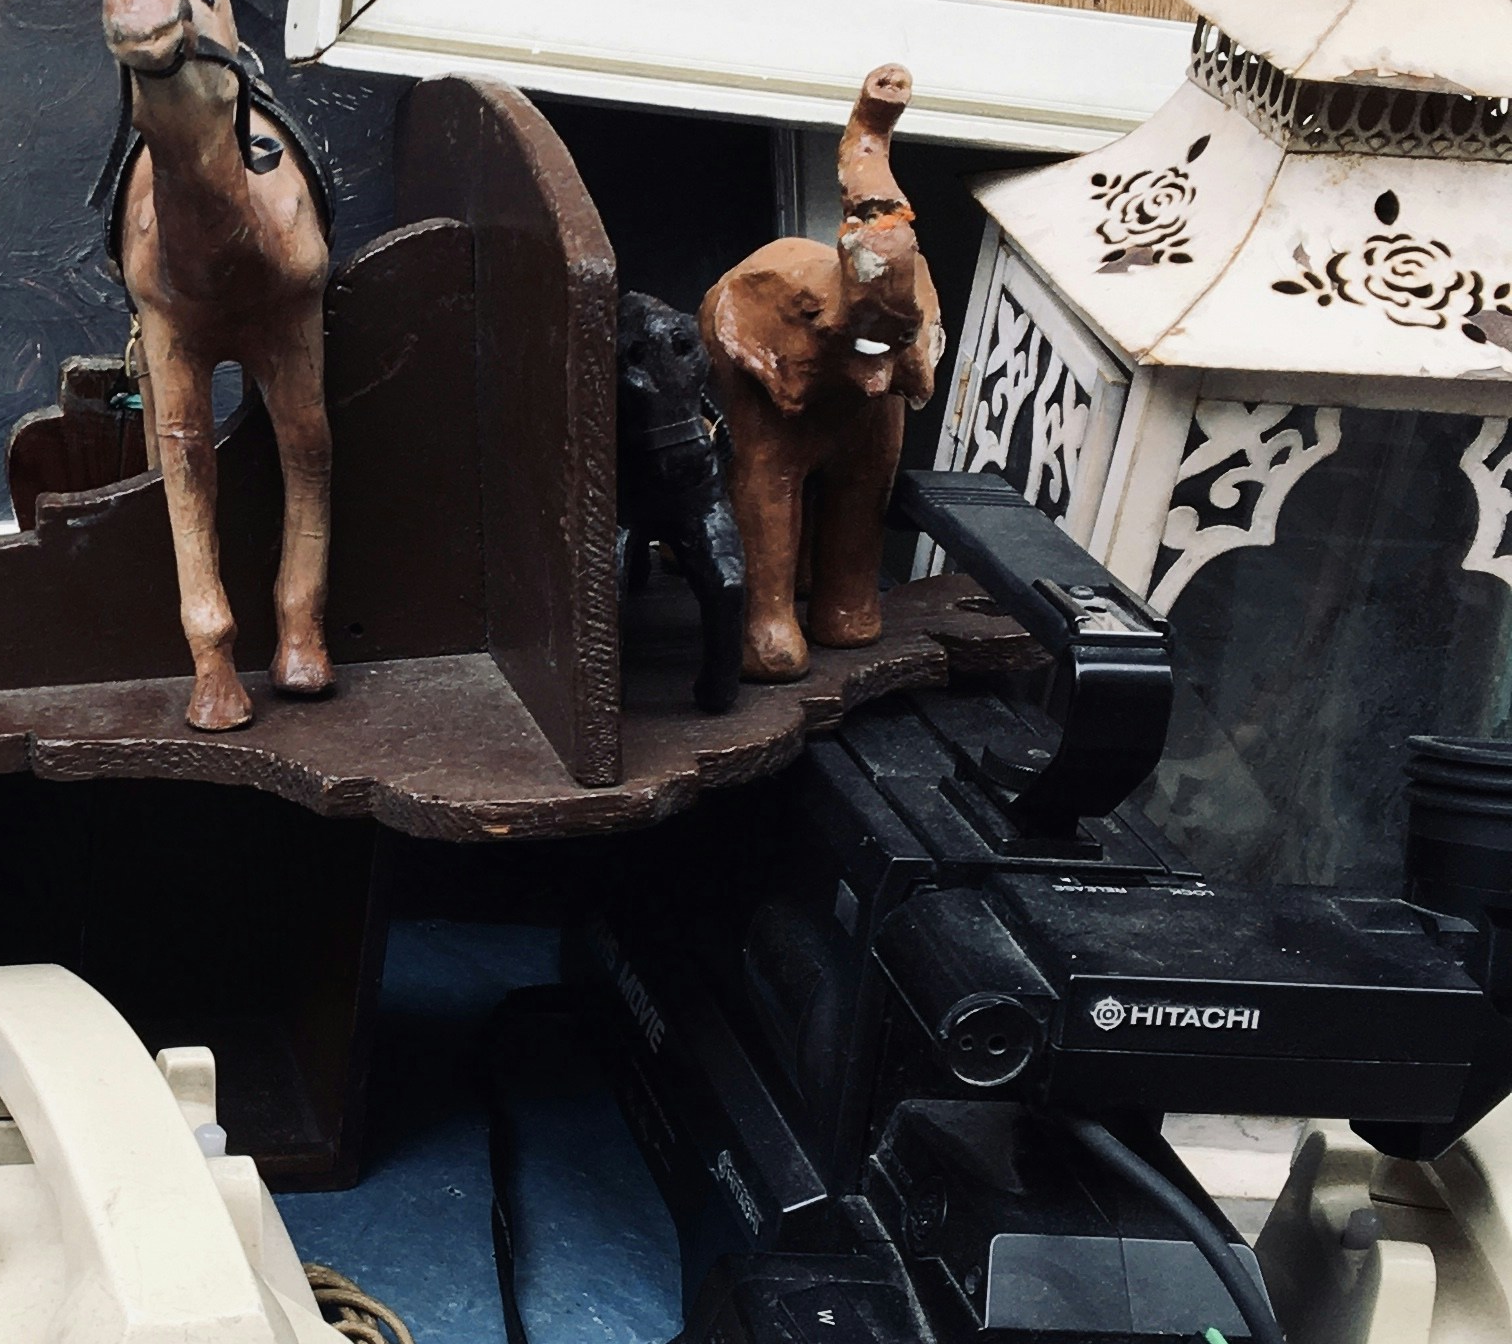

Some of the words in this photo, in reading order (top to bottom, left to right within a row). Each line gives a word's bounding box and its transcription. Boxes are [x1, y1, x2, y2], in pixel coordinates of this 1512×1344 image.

[617, 960, 666, 1054] MOVIE
[1130, 1005, 1260, 1029] HITACHI
[726, 1167, 760, 1235] HITACHI
[817, 1309, 835, 1325] W
